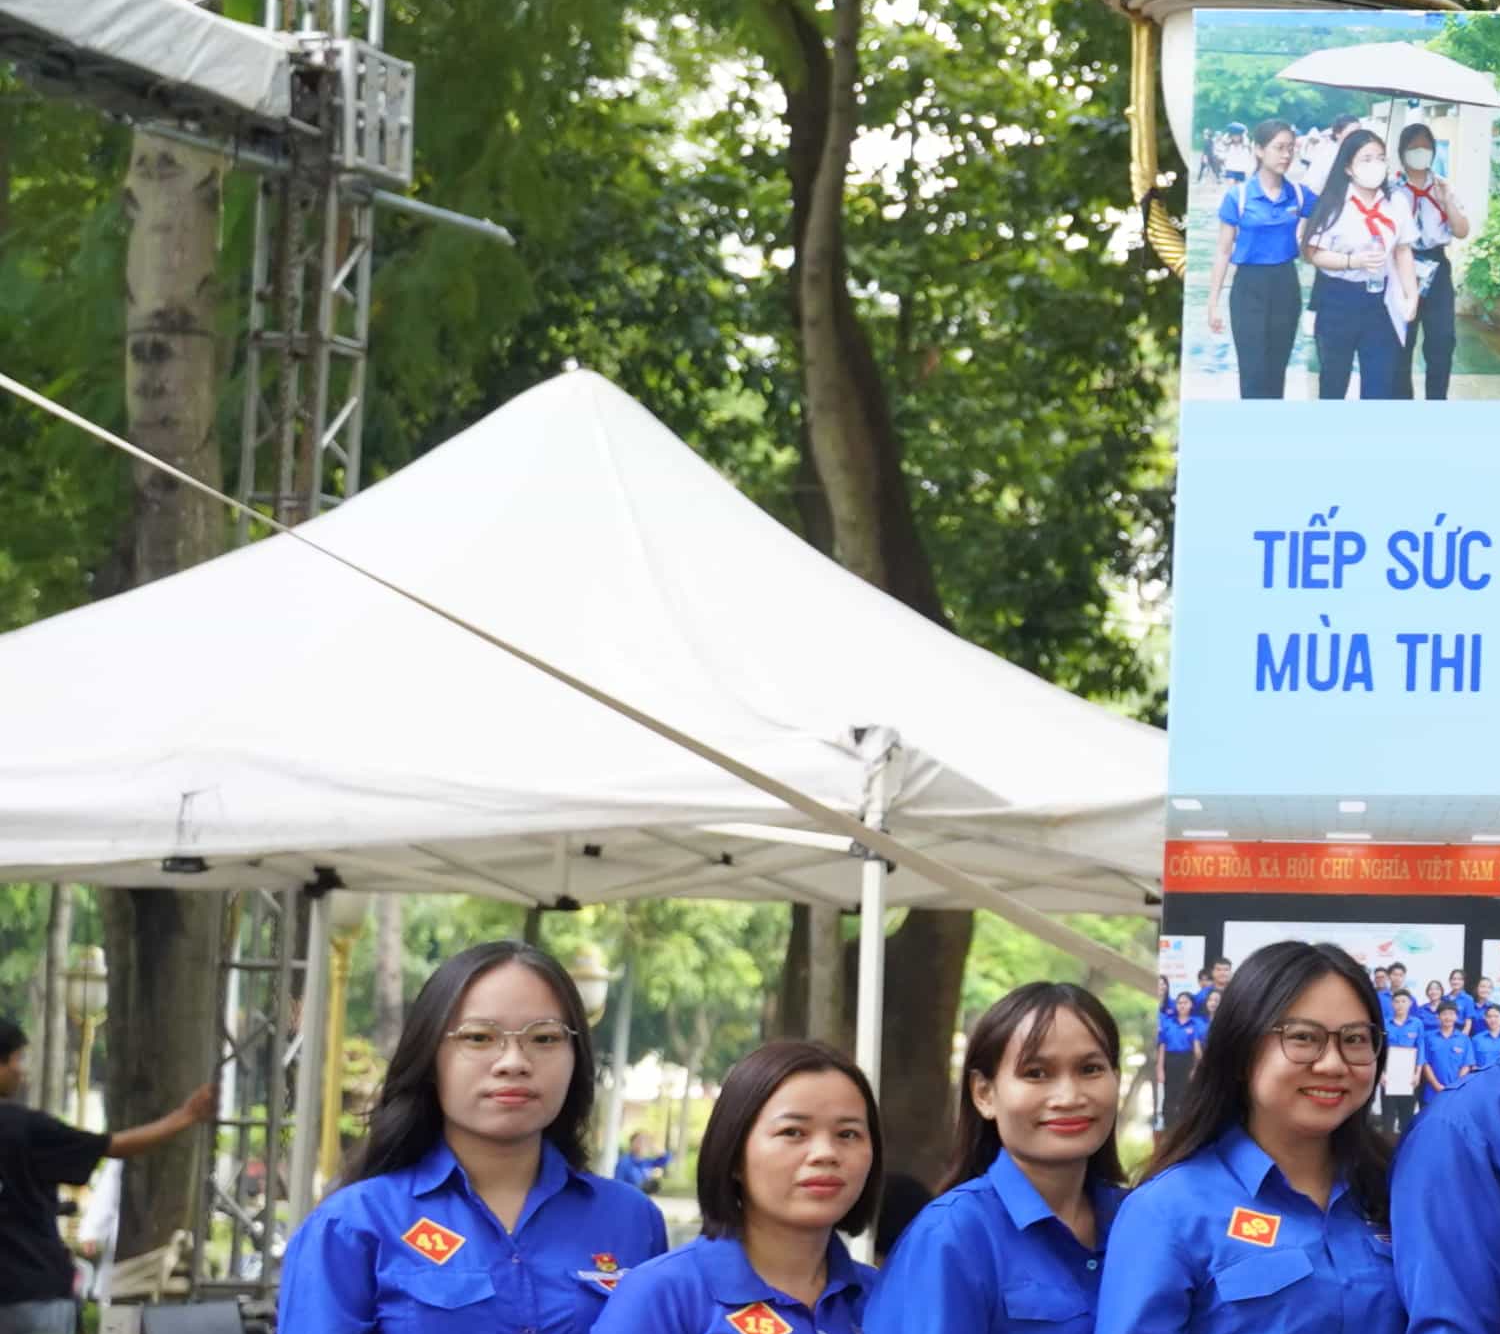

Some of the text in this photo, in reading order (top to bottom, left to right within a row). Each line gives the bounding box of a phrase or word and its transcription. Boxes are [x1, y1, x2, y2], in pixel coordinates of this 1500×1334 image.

[1254, 506, 1491, 590] TIẾP SỨC
[1256, 614, 1481, 692] MÙA THI
[416, 1233, 448, 1250] 41
[745, 1316, 775, 1334] 15
